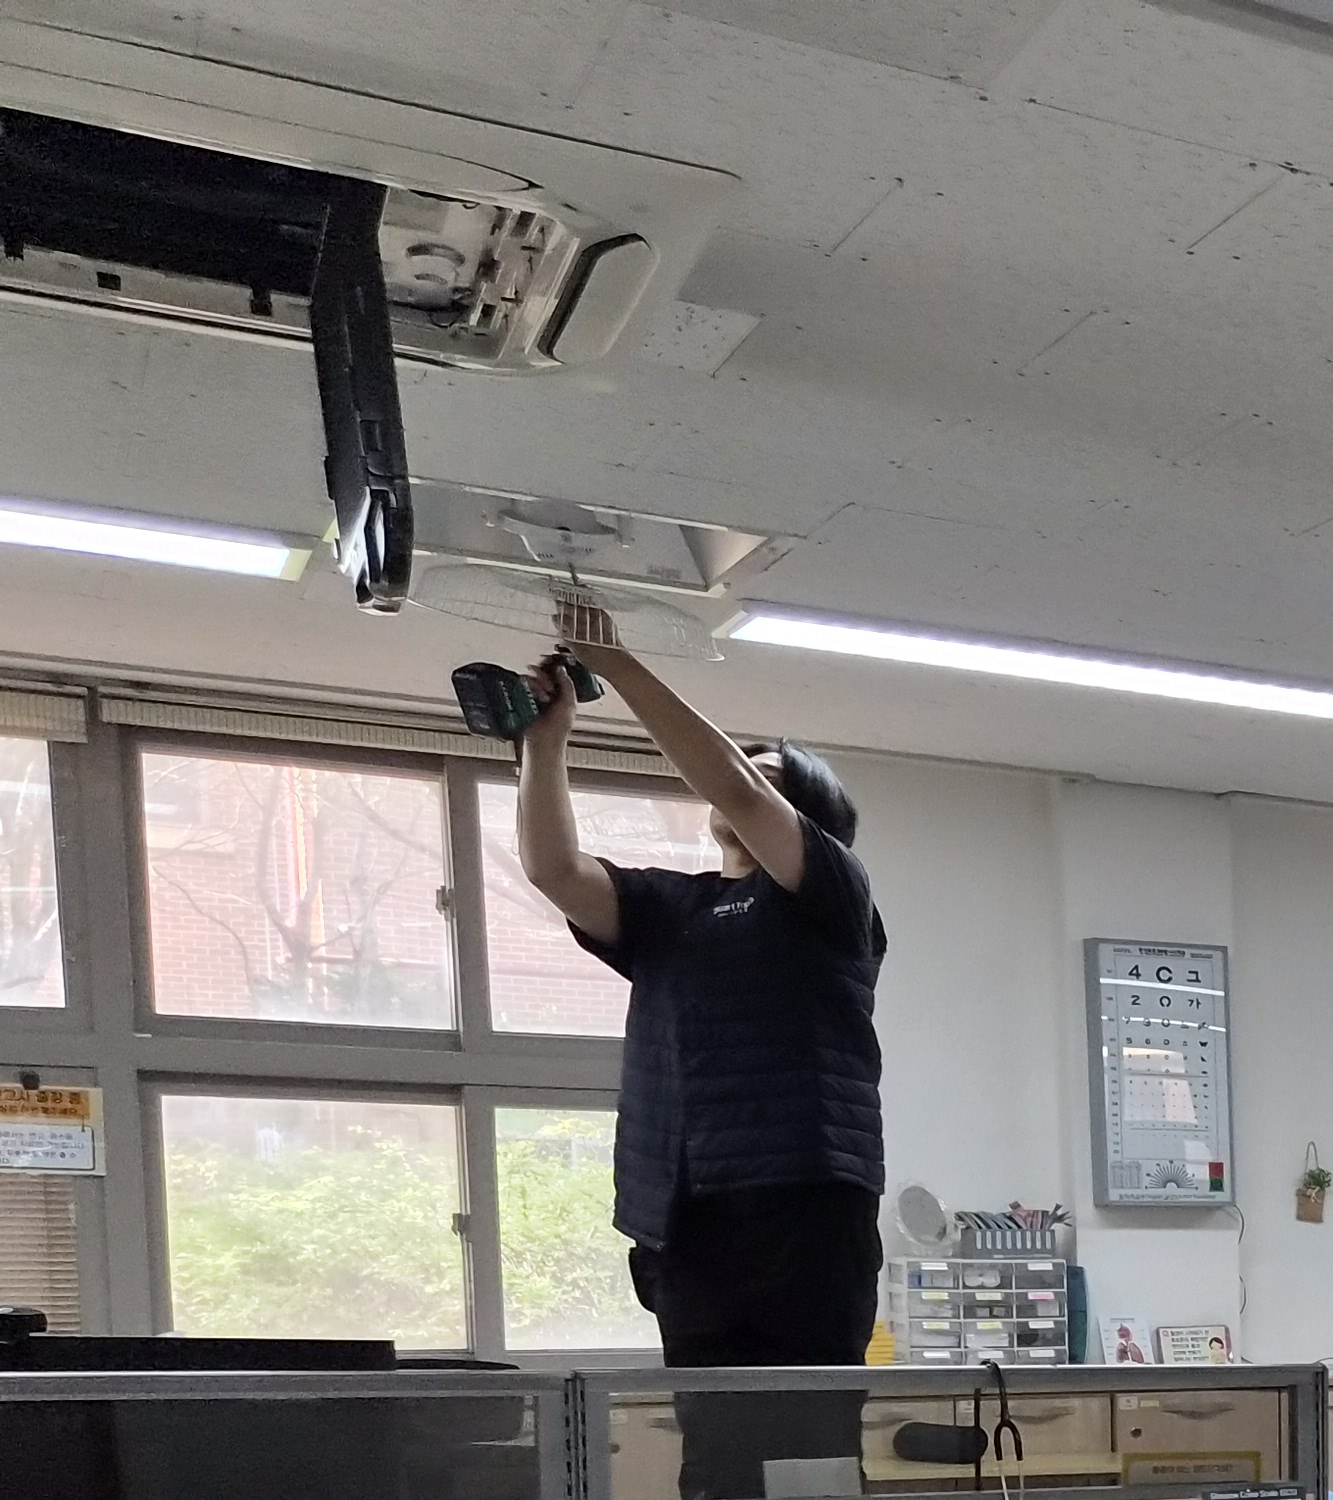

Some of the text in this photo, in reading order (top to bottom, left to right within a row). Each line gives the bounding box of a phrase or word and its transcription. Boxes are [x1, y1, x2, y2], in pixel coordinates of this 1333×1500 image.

[1128, 964, 1142, 980] 4
[1131, 995, 1202, 1010] 2 가
